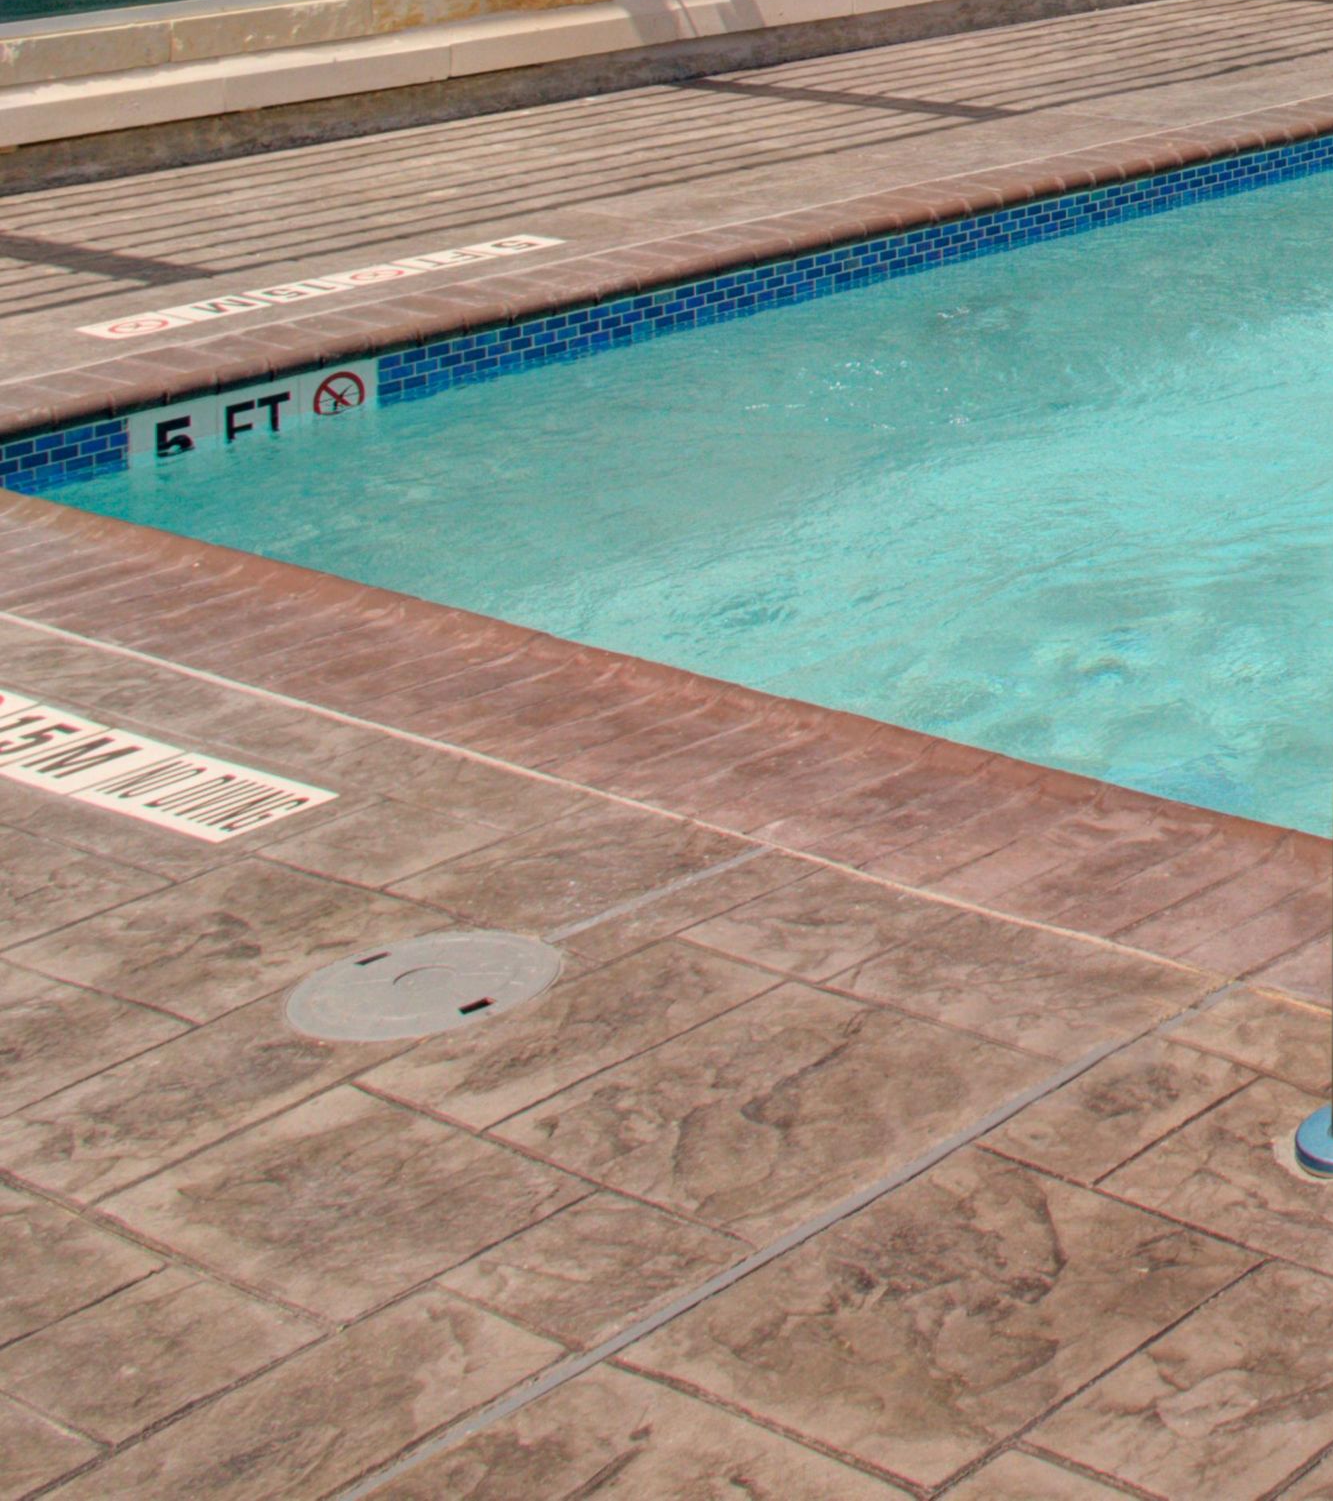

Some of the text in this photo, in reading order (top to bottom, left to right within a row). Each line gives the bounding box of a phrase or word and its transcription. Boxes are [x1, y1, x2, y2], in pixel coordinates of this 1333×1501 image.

[415, 251, 482, 267] FT
[190, 297, 259, 314] M
[156, 391, 291, 457] 5 FT
[22, 736, 143, 778] M
[95, 760, 207, 799] NO
[142, 774, 310, 832] DIVING
